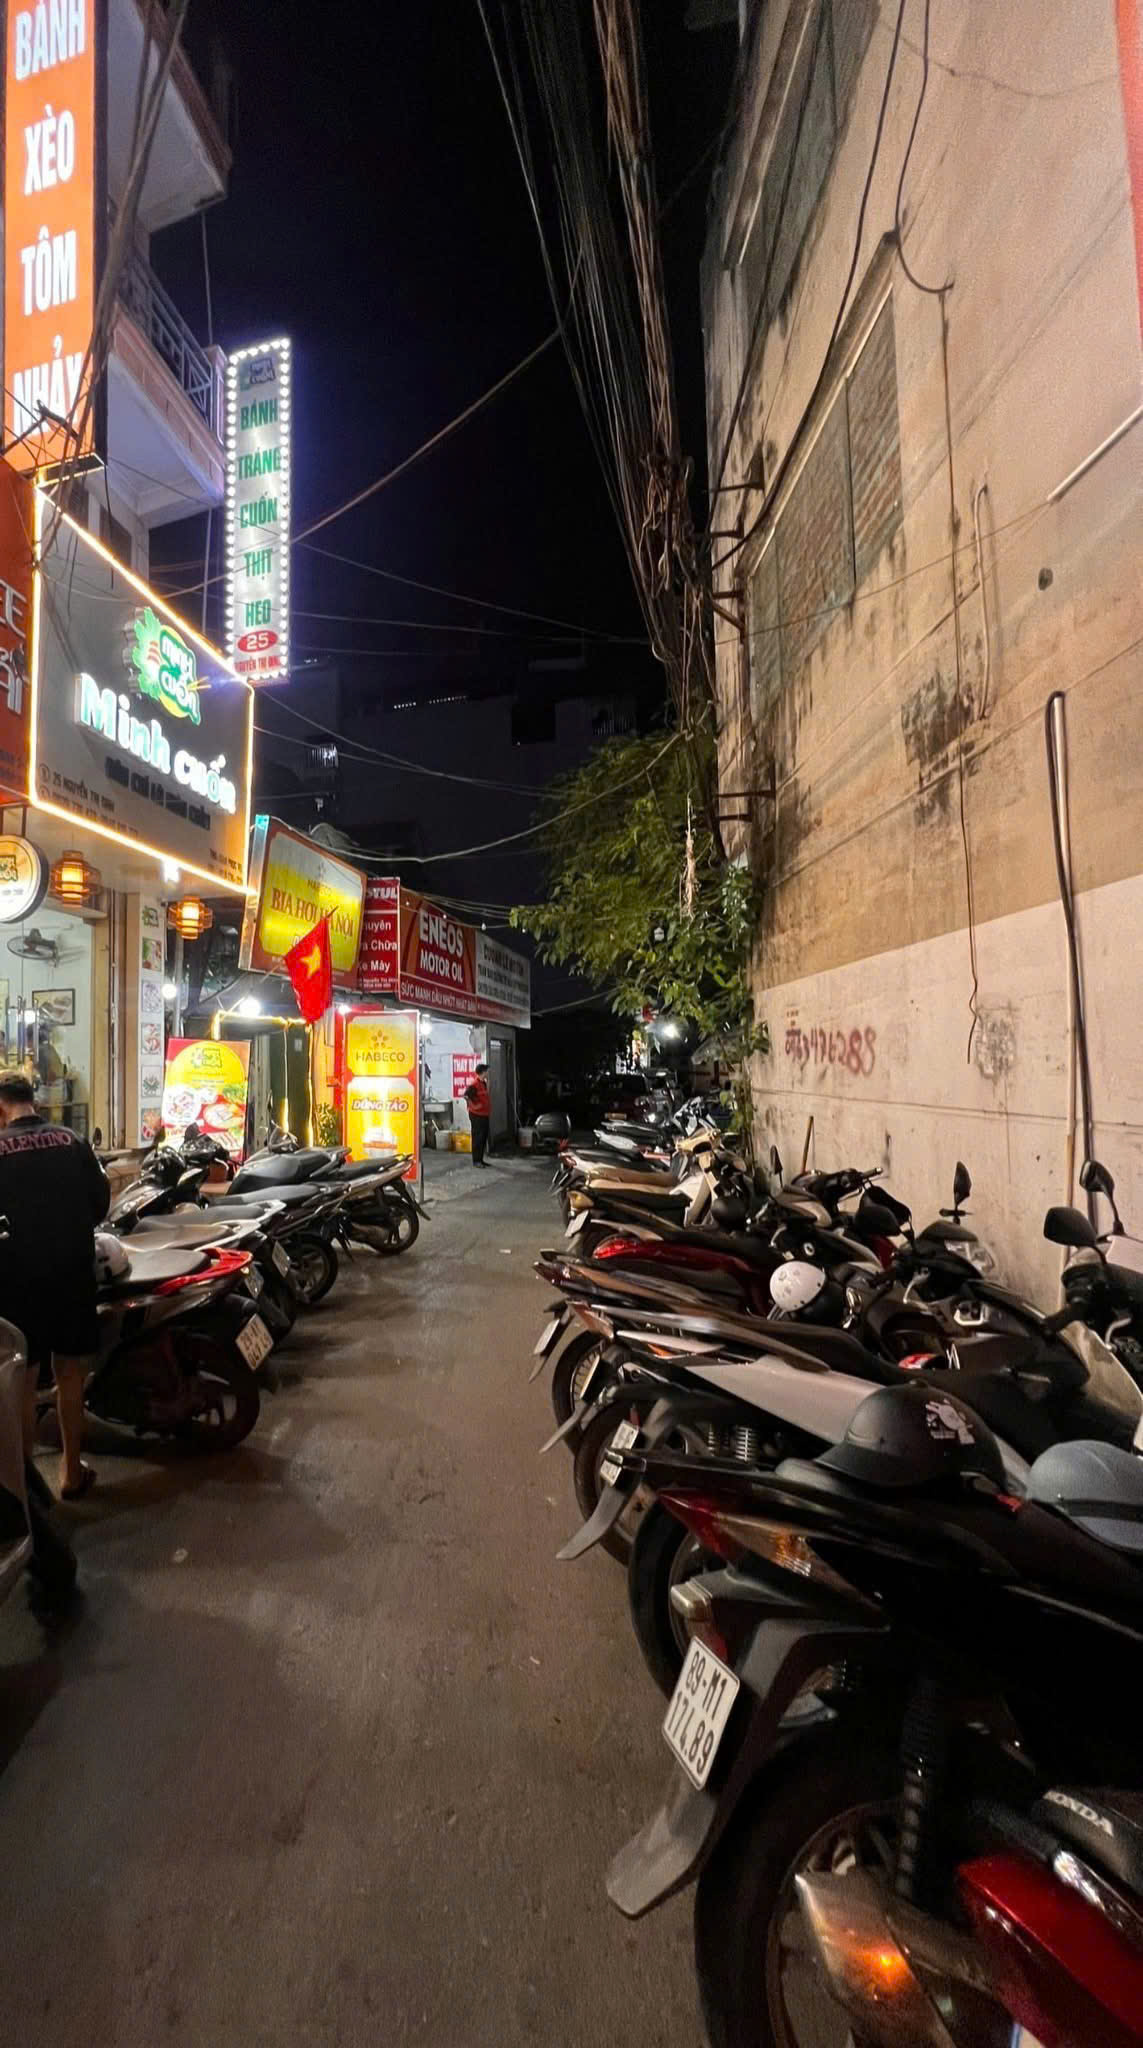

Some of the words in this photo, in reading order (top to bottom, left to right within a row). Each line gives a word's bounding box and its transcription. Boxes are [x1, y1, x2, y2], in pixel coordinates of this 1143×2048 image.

[24, 104, 75, 196] XÈO
[21, 225, 77, 317] TÔM
[13, 335, 83, 438] NHẢY
[240, 398, 278, 431] BÁNH
[238, 447, 281, 480] TRÁNG
[240, 491, 278, 529] CUỐN
[244, 548, 273, 580] THỊT
[245, 599, 272, 627] HEO
[246, 632, 269, 650] 25
[77, 672, 171, 775] Minh
[271, 887, 293, 917] BIA
[420, 908, 464, 958] ENEOS
[371, 960, 391, 973] Máy
[420, 950, 450, 978] MOTOR
[452, 962, 464, 983] OIL
[401, 979, 414, 998] SỨC
[356, 1052, 405, 1062] HABECO
[686, 1650, 728, 1721] 89-M1
